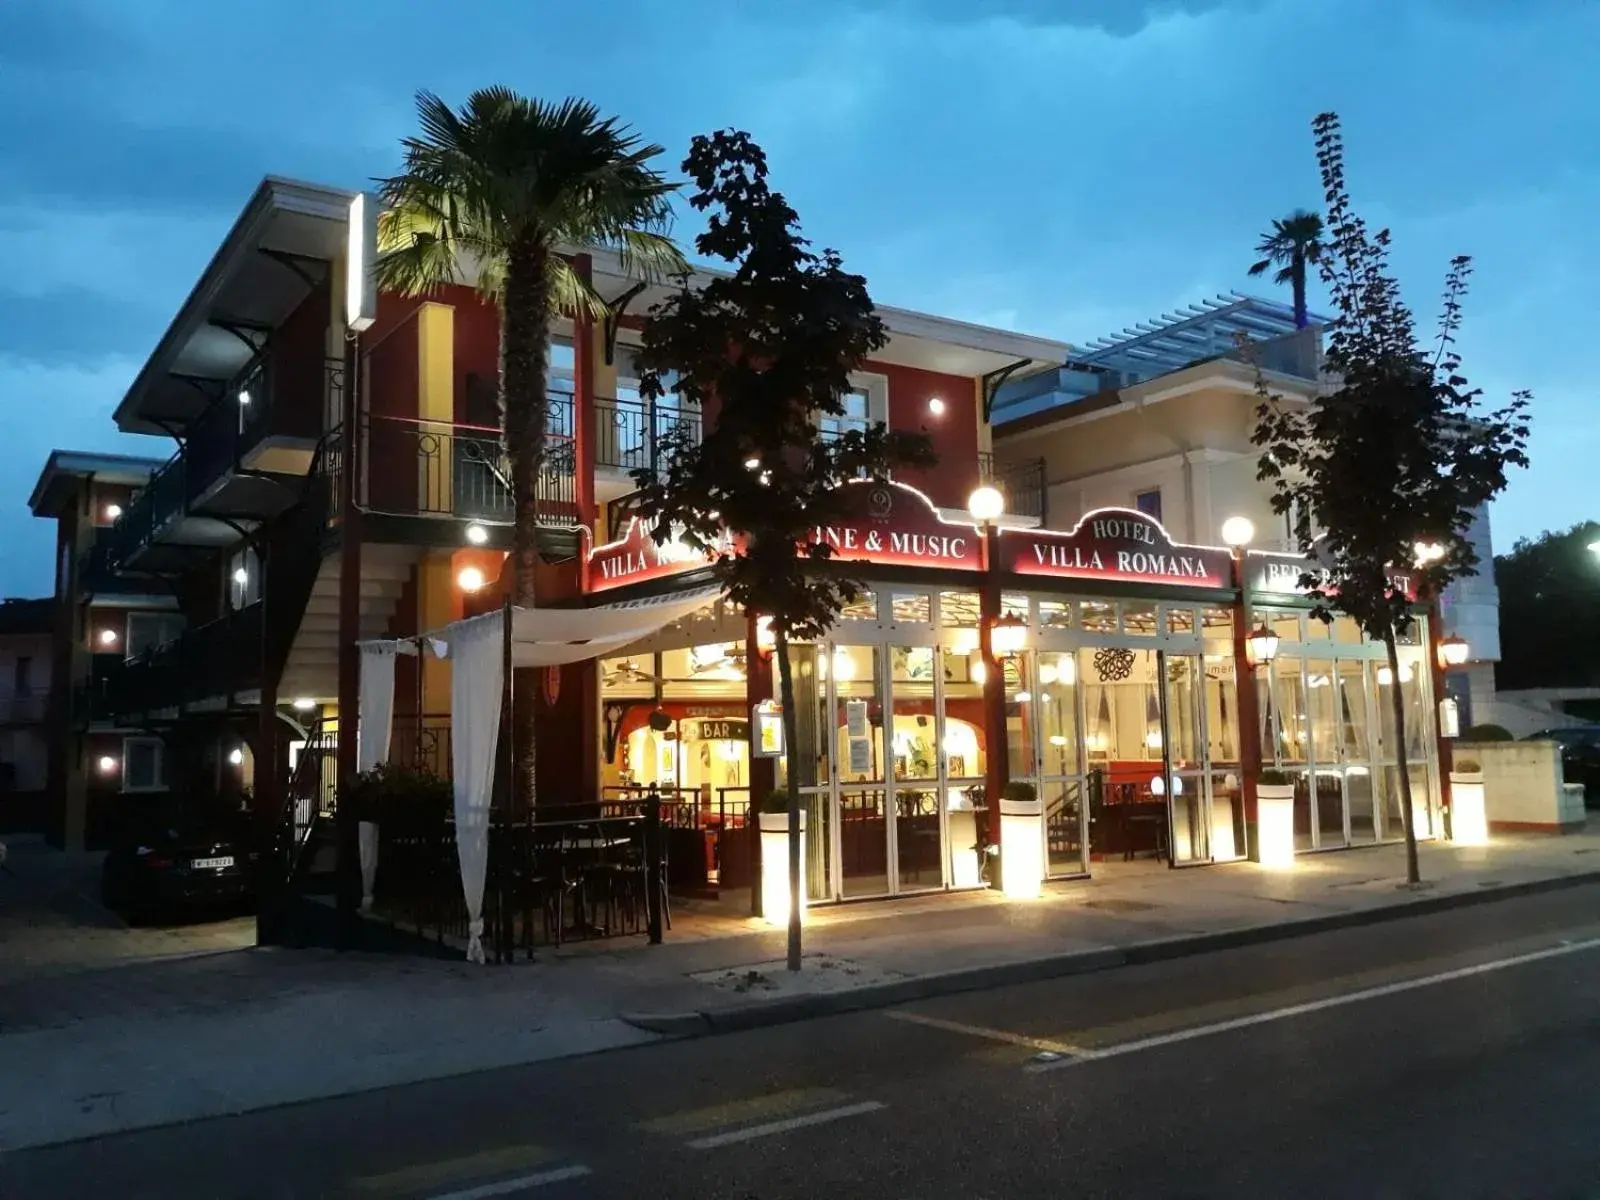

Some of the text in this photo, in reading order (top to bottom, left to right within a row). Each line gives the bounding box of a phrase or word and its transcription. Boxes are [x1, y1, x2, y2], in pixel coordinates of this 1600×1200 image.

[865, 530, 883, 552] &
[889, 532, 965, 559] MUSIC
[1093, 519, 1155, 545] HOTEL
[601, 550, 647, 580] VILLA
[1033, 543, 1208, 578] VILLA ROMANA
[703, 722, 730, 738] BAR
